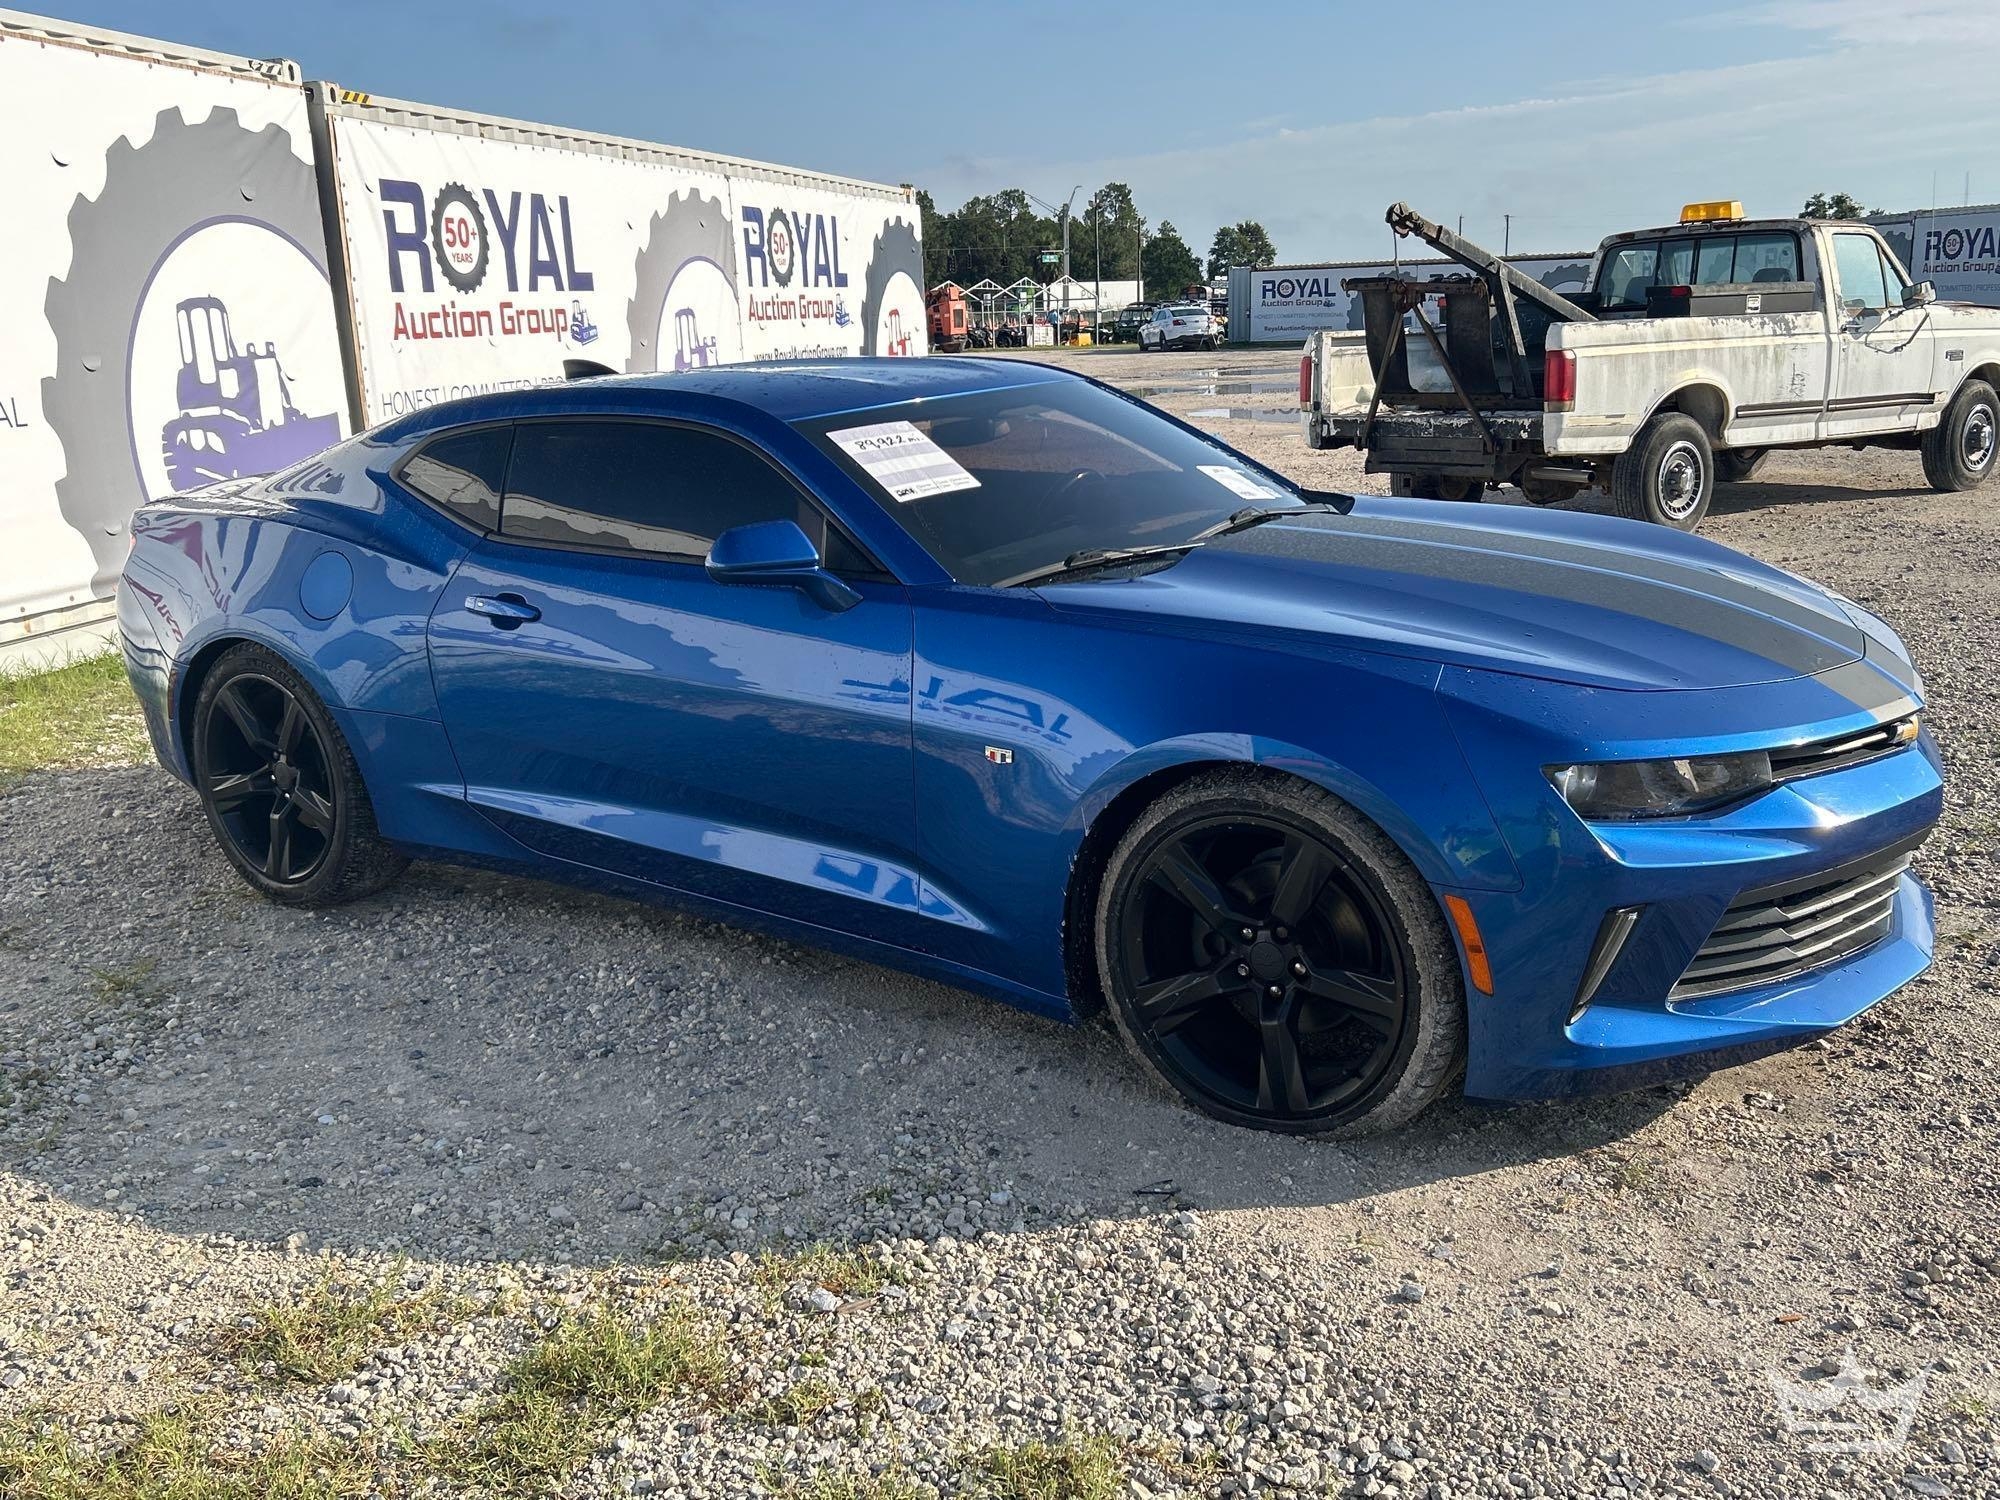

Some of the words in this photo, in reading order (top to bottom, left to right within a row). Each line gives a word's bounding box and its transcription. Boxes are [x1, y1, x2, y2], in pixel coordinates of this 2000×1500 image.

[378, 178, 595, 294] ROYAL
[444, 217, 477, 248] 50+
[1924, 227, 2000, 261] ROYA
[452, 252, 473, 263] YEARS
[741, 205, 848, 289] ROYAL
[1922, 262, 1959, 273] Auction
[1962, 261, 1994, 274] Group
[1261, 278, 1336, 299] ROYAL
[749, 293, 797, 321] Auction
[799, 294, 834, 325] Group
[1296, 299, 1322, 307] Group
[393, 301, 494, 340] Auction
[499, 301, 568, 342] Group
[1264, 325, 1333, 333] RoyalAuctionGroup.com
[381, 388, 439, 416] HONEST
[854, 435, 906, 450] 89,922
